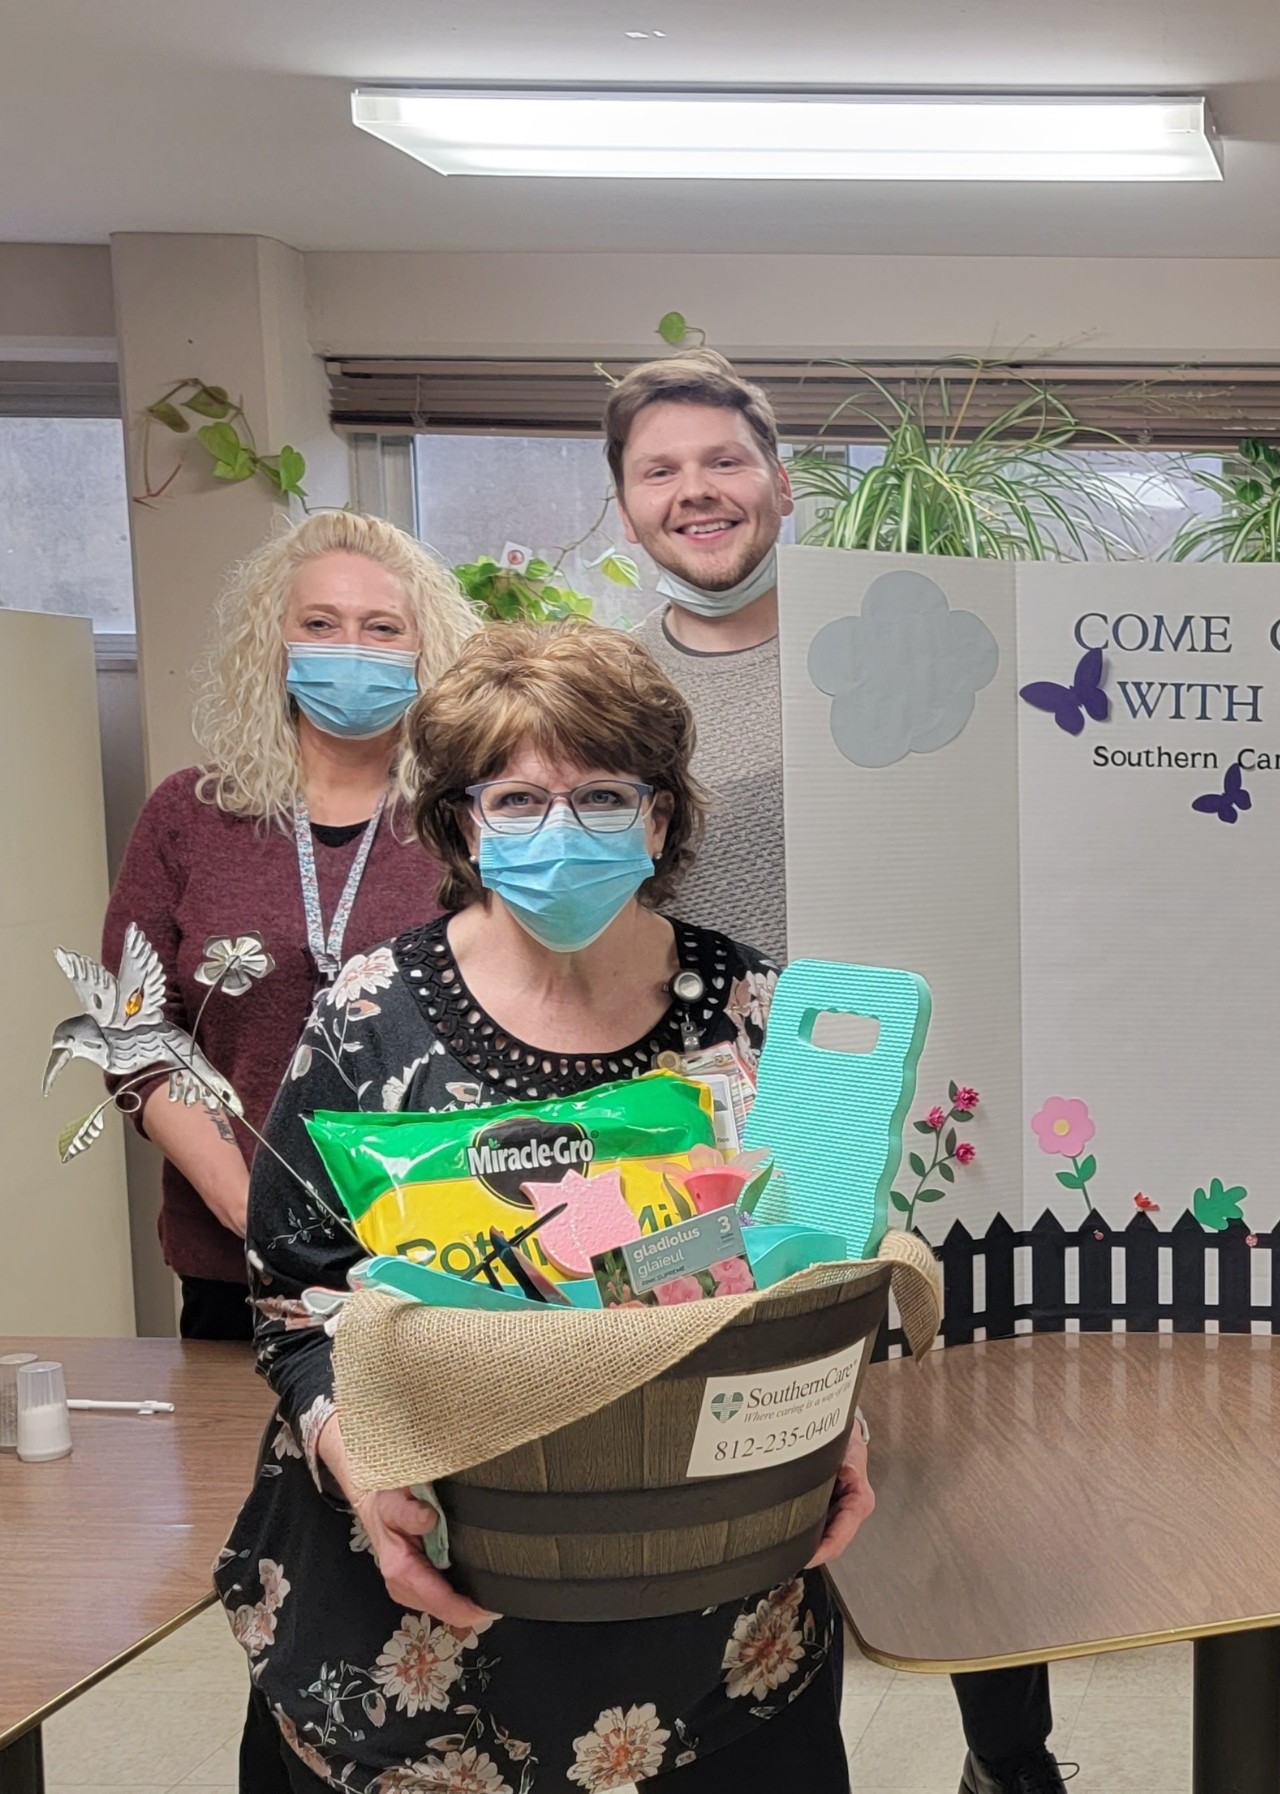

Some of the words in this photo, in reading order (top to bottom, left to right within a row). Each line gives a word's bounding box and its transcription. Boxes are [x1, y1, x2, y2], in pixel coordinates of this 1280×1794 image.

[1074, 612, 1233, 653] COME
[1116, 681, 1264, 723] WITH
[1093, 745, 1219, 769] Southern
[467, 1136, 594, 1175] Miracle-Gro
[633, 1226, 700, 1263] gladiolus
[716, 1215, 731, 1234] 3
[637, 1249, 685, 1279] glaïeul
[747, 1366, 852, 1408] SouthernCare
[744, 1410, 775, 1424] Where
[776, 1404, 805, 1419] caring
[805, 1400, 813, 1410] is
[713, 1407, 842, 1462] 812-235-0400
